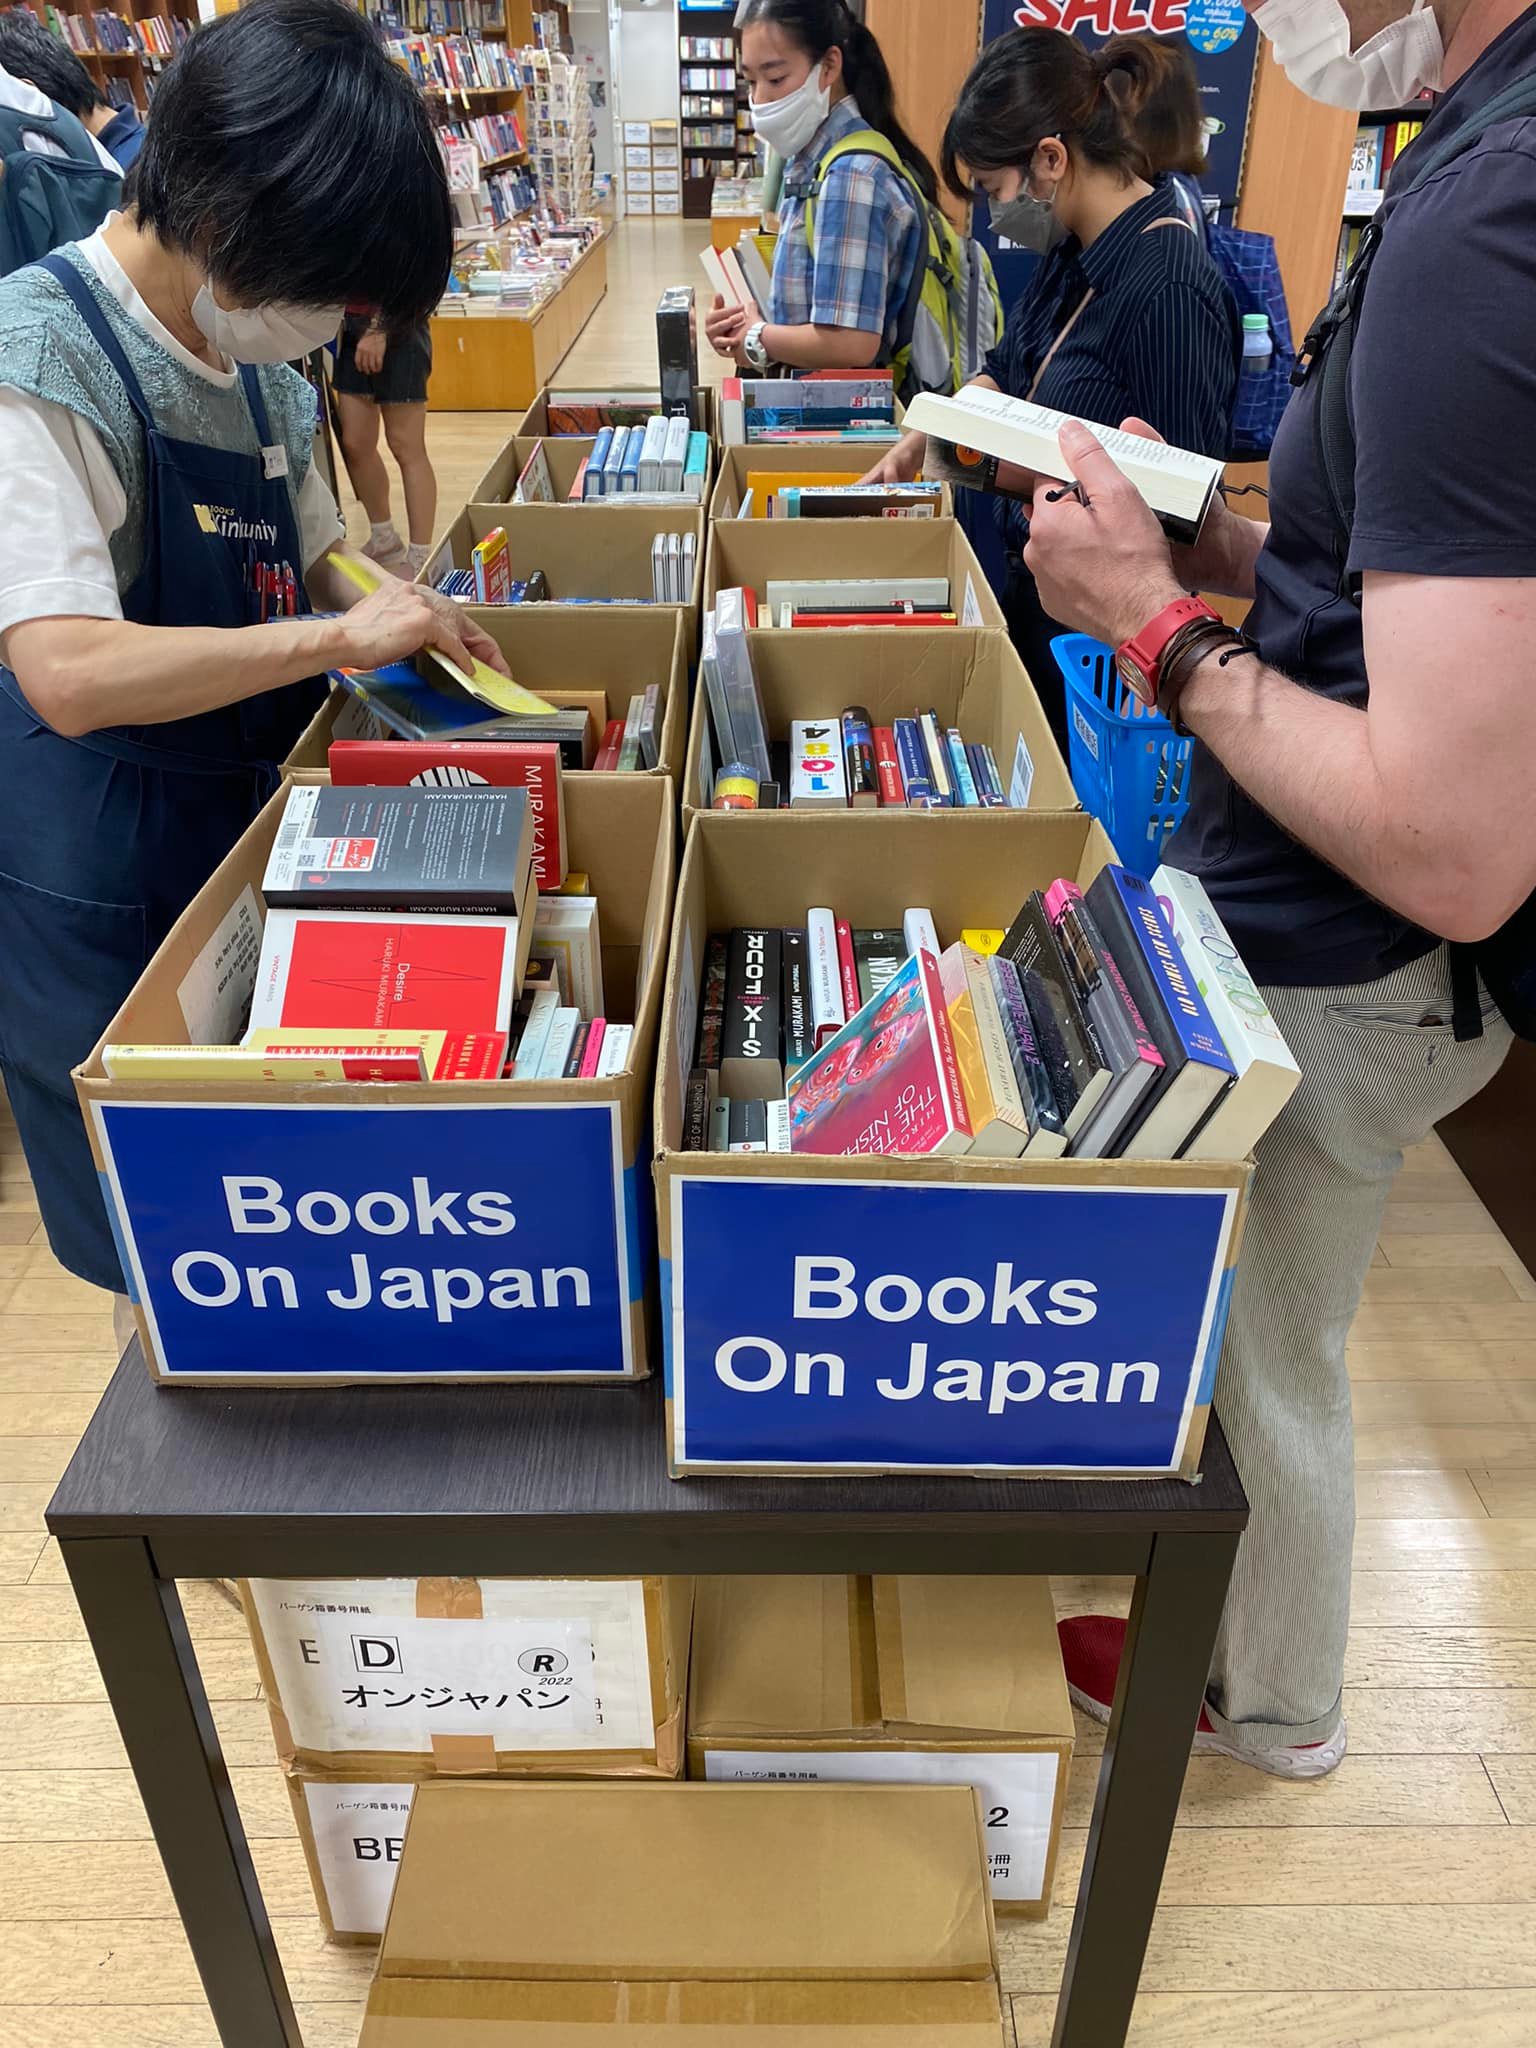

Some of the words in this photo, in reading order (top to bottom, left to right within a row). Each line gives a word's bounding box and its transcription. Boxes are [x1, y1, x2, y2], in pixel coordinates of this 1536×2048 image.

[1014, 0, 1187, 34] SALE
[1213, 26, 1238, 41] 60%
[524, 765, 547, 880] MURAKAMI
[409, 904, 461, 912] MURAKAMI
[269, 955, 281, 983] VINTAGE
[380, 937, 394, 973] HARUKI
[745, 935, 764, 995] FOUR
[1101, 949, 1127, 994] MONONOKE
[373, 974, 389, 1027] MURAKAMI
[393, 962, 411, 1002] Desire
[742, 1005, 763, 1058] SIX
[792, 994, 803, 1038] MURAKAMI
[1122, 994, 1147, 1033] PRINCESS
[456, 1034, 476, 1067] HARUKI
[1015, 1021, 1035, 1054] JAPAN
[1026, 1054, 1040, 1066] 2
[893, 1084, 916, 1116] OF
[897, 1085, 938, 1133] THE
[222, 1175, 516, 1236] Books
[171, 1250, 299, 1309] On
[326, 1253, 591, 1324] Japan
[793, 1255, 1098, 1326] Books
[714, 1336, 845, 1398] On
[876, 1342, 1160, 1415] Japan
[279, 1602, 372, 1614] バーゲン箱番号用紙
[359, 1639, 395, 1668] D
[532, 1654, 555, 1672] R
[341, 1685, 571, 1711] オンジャパン
[538, 1677, 573, 1686] 2022
